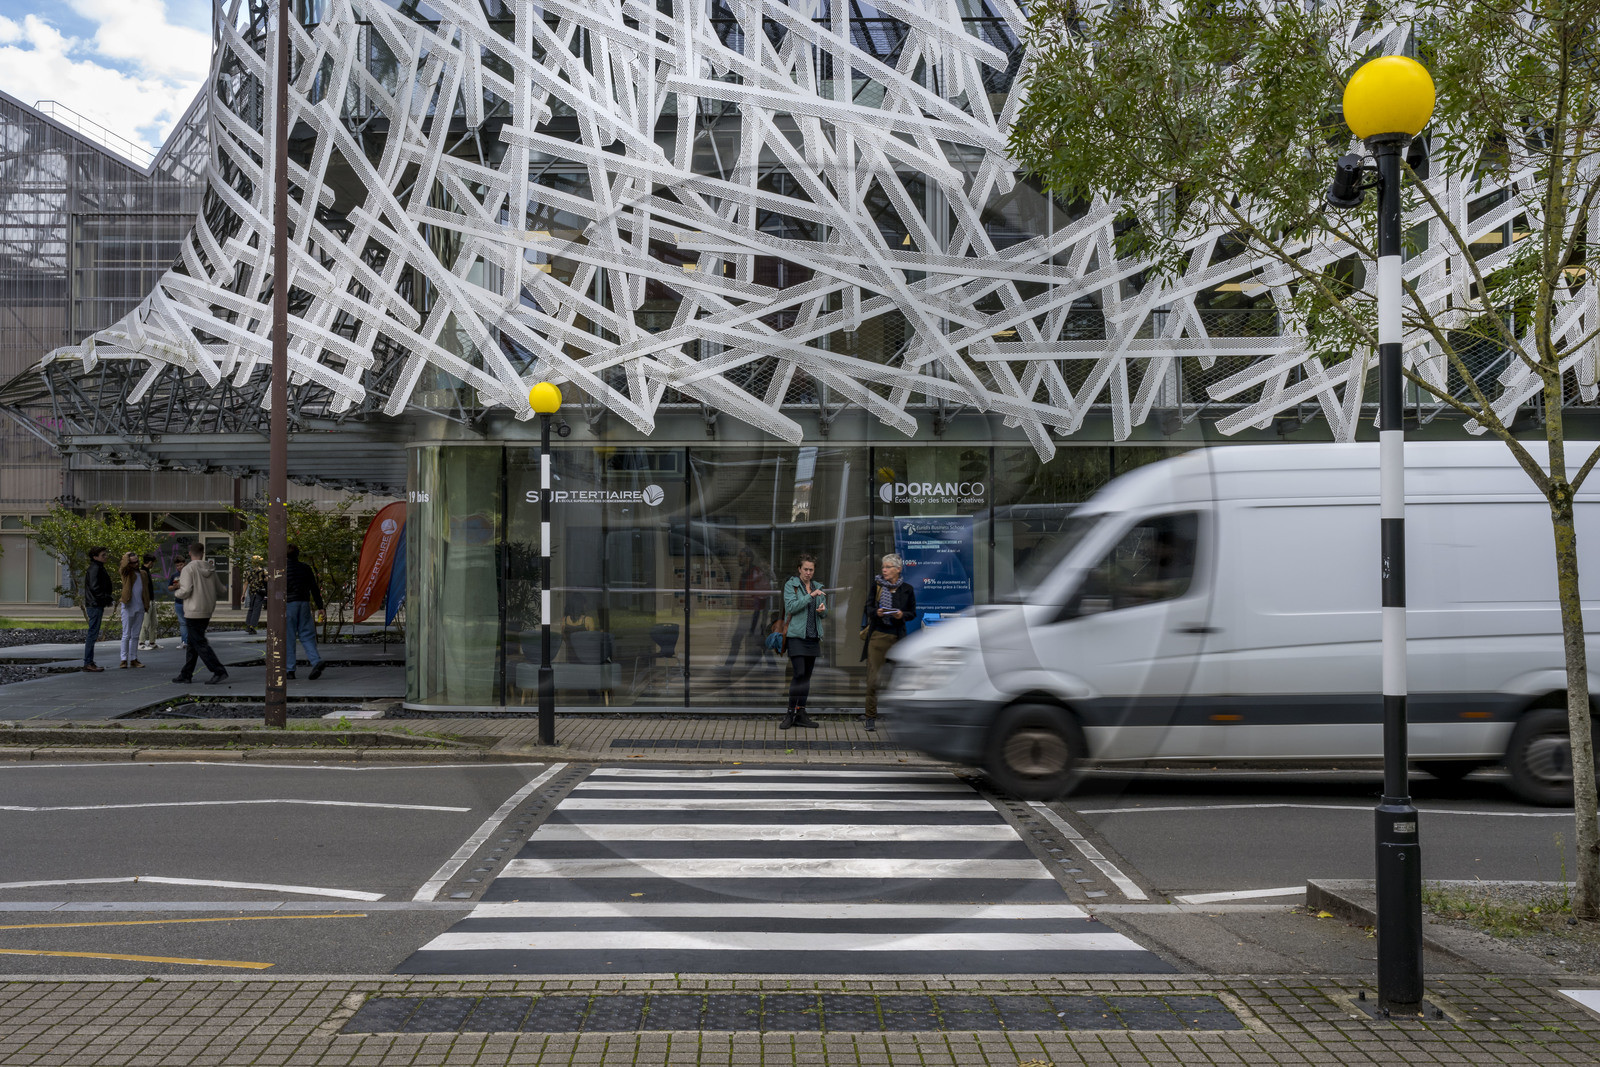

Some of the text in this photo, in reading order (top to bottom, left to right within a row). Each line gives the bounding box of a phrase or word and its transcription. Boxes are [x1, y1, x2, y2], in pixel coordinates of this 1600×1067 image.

[895, 482, 985, 496] DORANCO
[409, 491, 430, 503] 19 bis
[913, 497, 927, 505] Sup'
